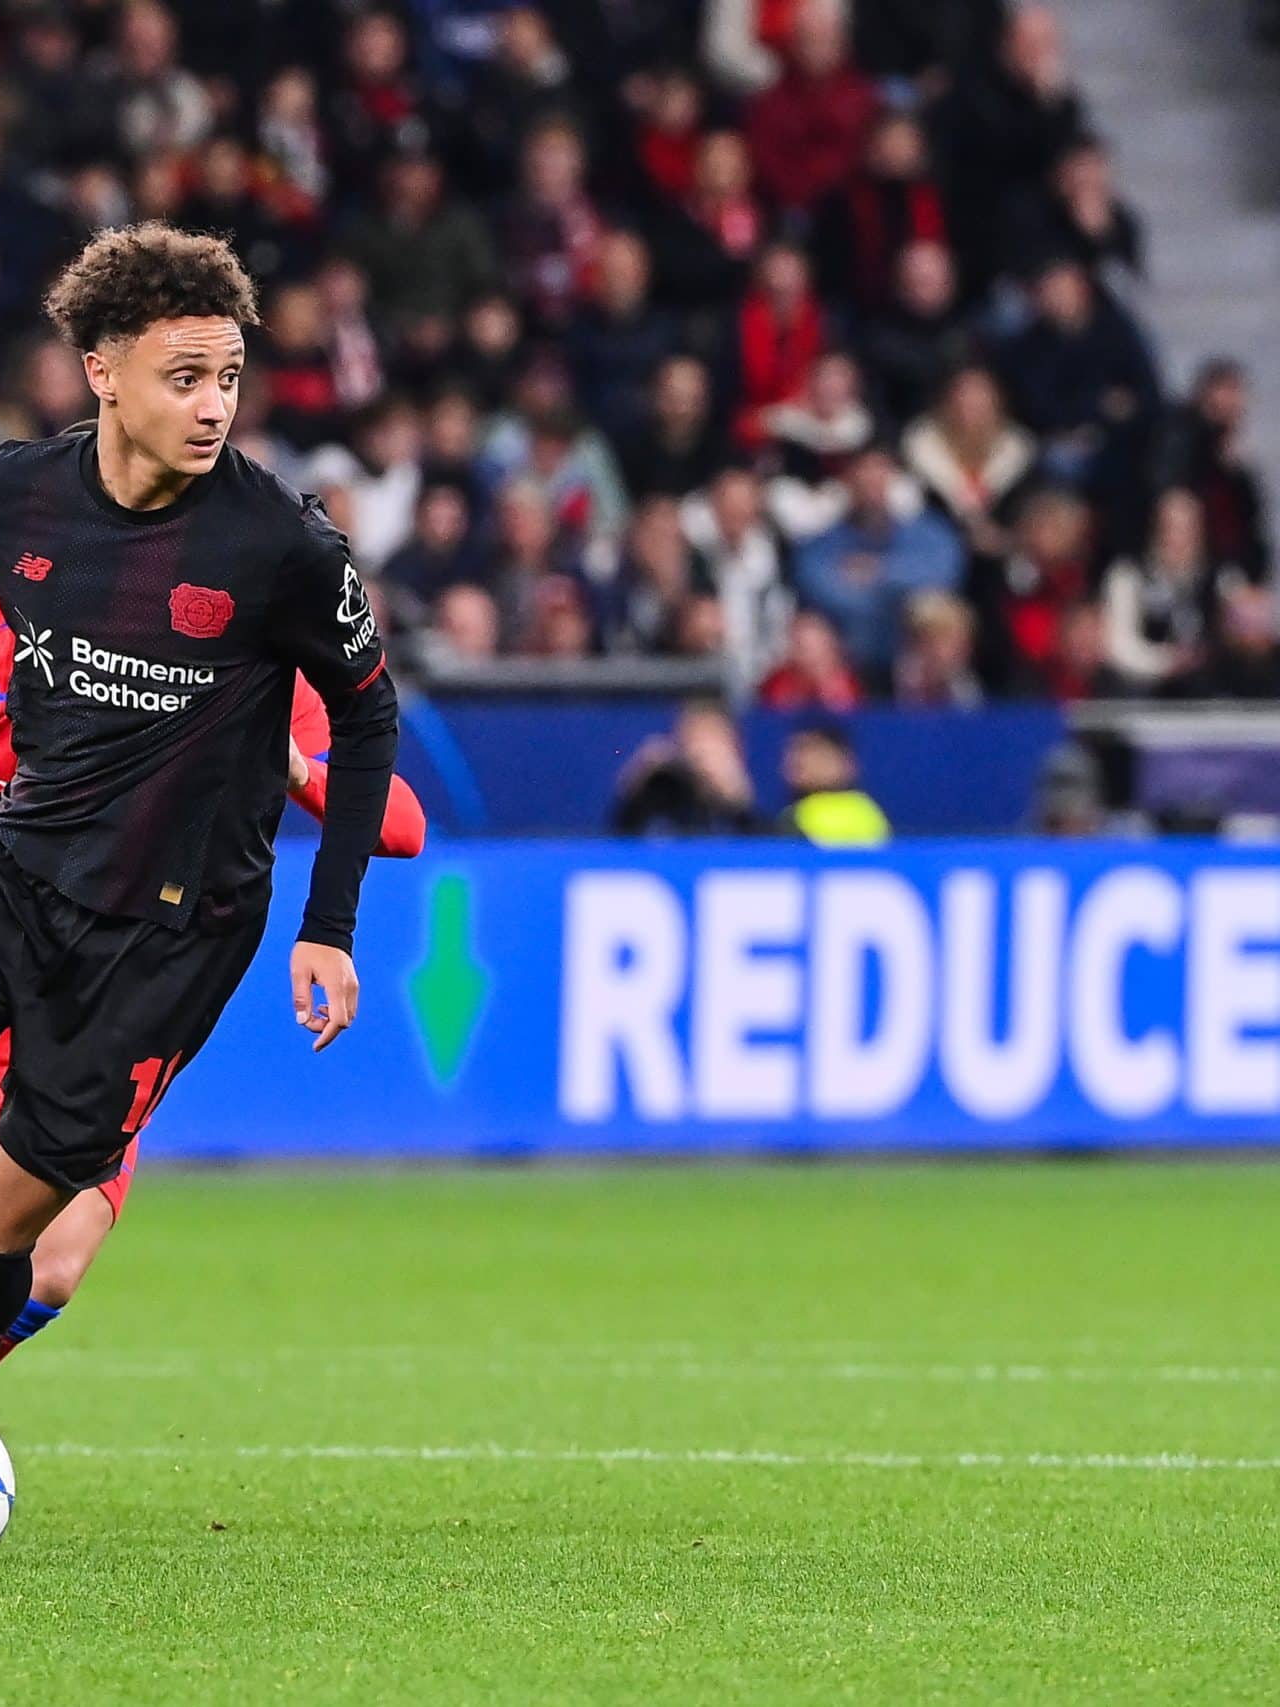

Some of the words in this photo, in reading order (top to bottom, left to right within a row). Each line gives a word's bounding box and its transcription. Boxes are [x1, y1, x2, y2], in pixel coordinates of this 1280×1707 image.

[69, 670, 192, 712] Gothaer
[72, 637, 214, 684] Barmenia
[558, 866, 1280, 1121] REDUCE
[121, 1049, 183, 1133] 1
